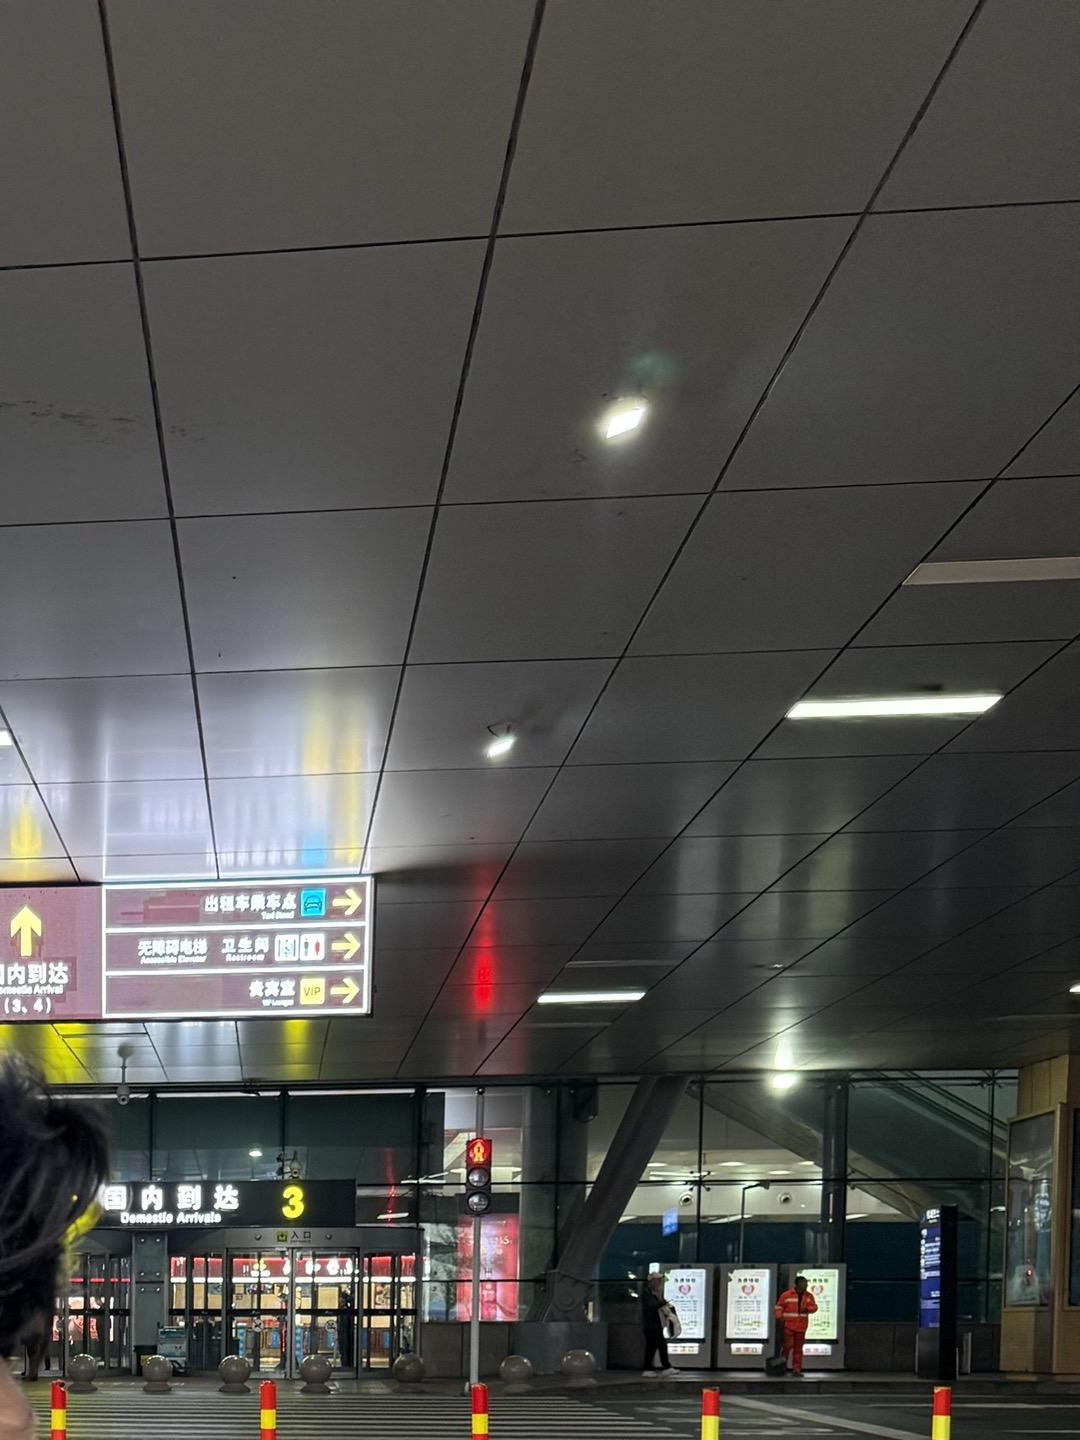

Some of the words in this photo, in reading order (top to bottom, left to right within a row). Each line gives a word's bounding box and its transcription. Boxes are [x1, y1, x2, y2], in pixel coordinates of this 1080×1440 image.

[204, 892, 297, 913] 出租车乘车点
[137, 938, 208, 956] 无障碍电梯
[221, 936, 270, 953] 卫生间
[225, 953, 265, 962] Restroom
[33, 984, 64, 994] Arrival
[248, 979, 296, 998] 贵宾室
[103, 1184, 240, 1211] 国内到达
[281, 1185, 305, 1219] 3
[120, 1210, 174, 1224] Domestic
[176, 1210, 222, 1224] Arrivals
[290, 1230, 312, 1240] 入口
